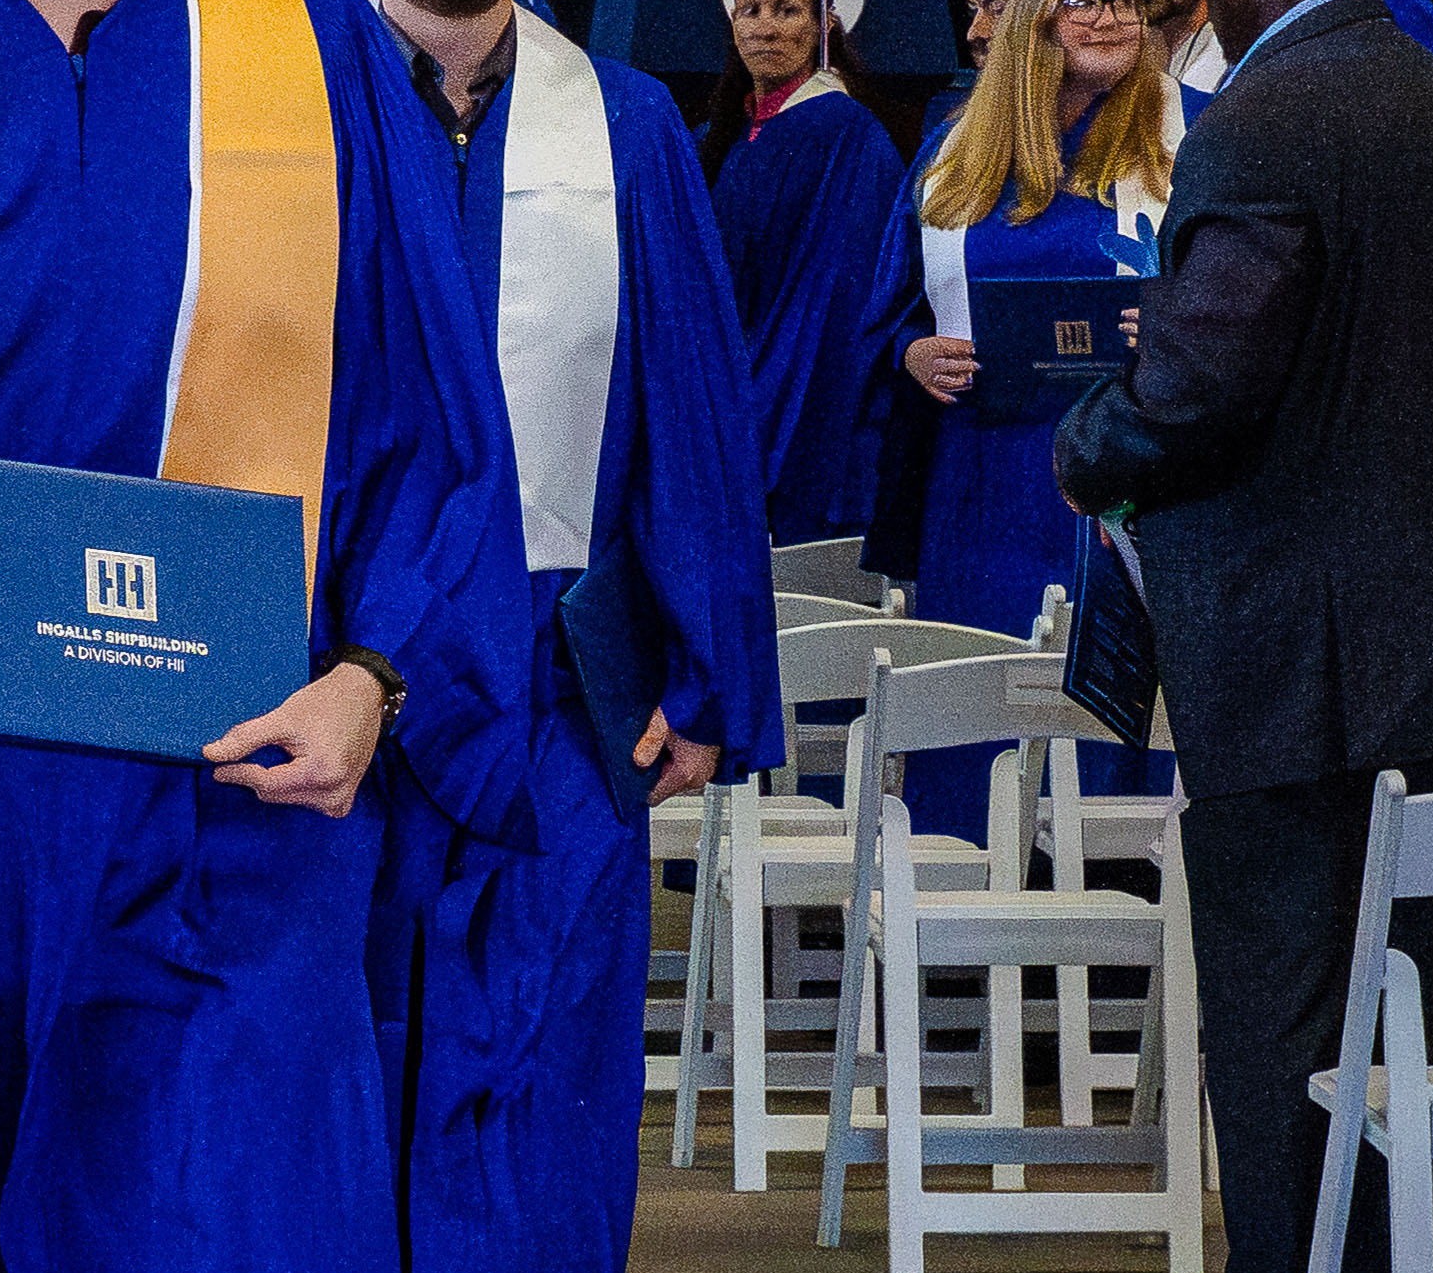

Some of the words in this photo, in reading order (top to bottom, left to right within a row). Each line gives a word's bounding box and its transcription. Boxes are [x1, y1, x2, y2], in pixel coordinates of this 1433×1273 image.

[37, 621, 102, 642] INGALLS
[104, 630, 209, 656] SHIPBUILDING
[63, 645, 76, 658] A
[77, 645, 142, 667] DIVISION
[144, 655, 165, 669] OF
[167, 658, 185, 673] HII
